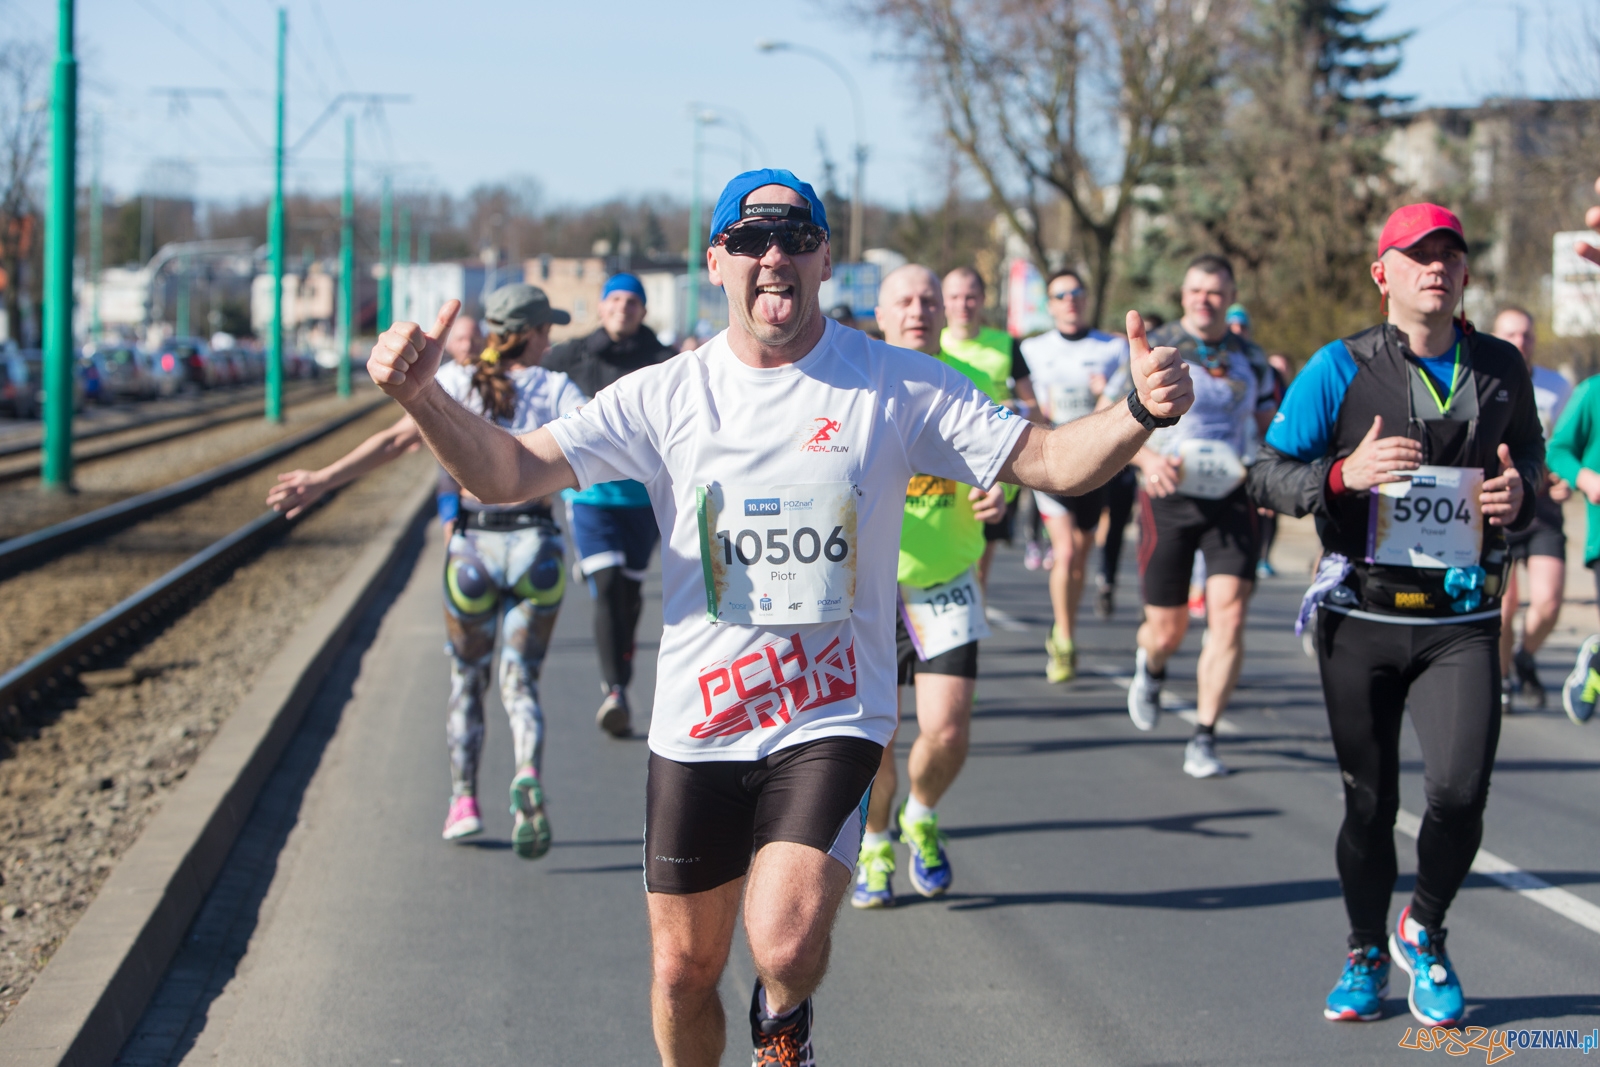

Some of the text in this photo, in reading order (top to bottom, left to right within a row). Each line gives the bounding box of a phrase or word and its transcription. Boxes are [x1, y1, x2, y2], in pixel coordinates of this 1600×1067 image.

[751, 206, 782, 214] Columbia
[747, 502, 778, 512] 10. PKO
[1393, 497, 1471, 524] 5904
[717, 525, 849, 566] 10506
[770, 571, 797, 581] Piotr
[698, 632, 808, 718] PCH
